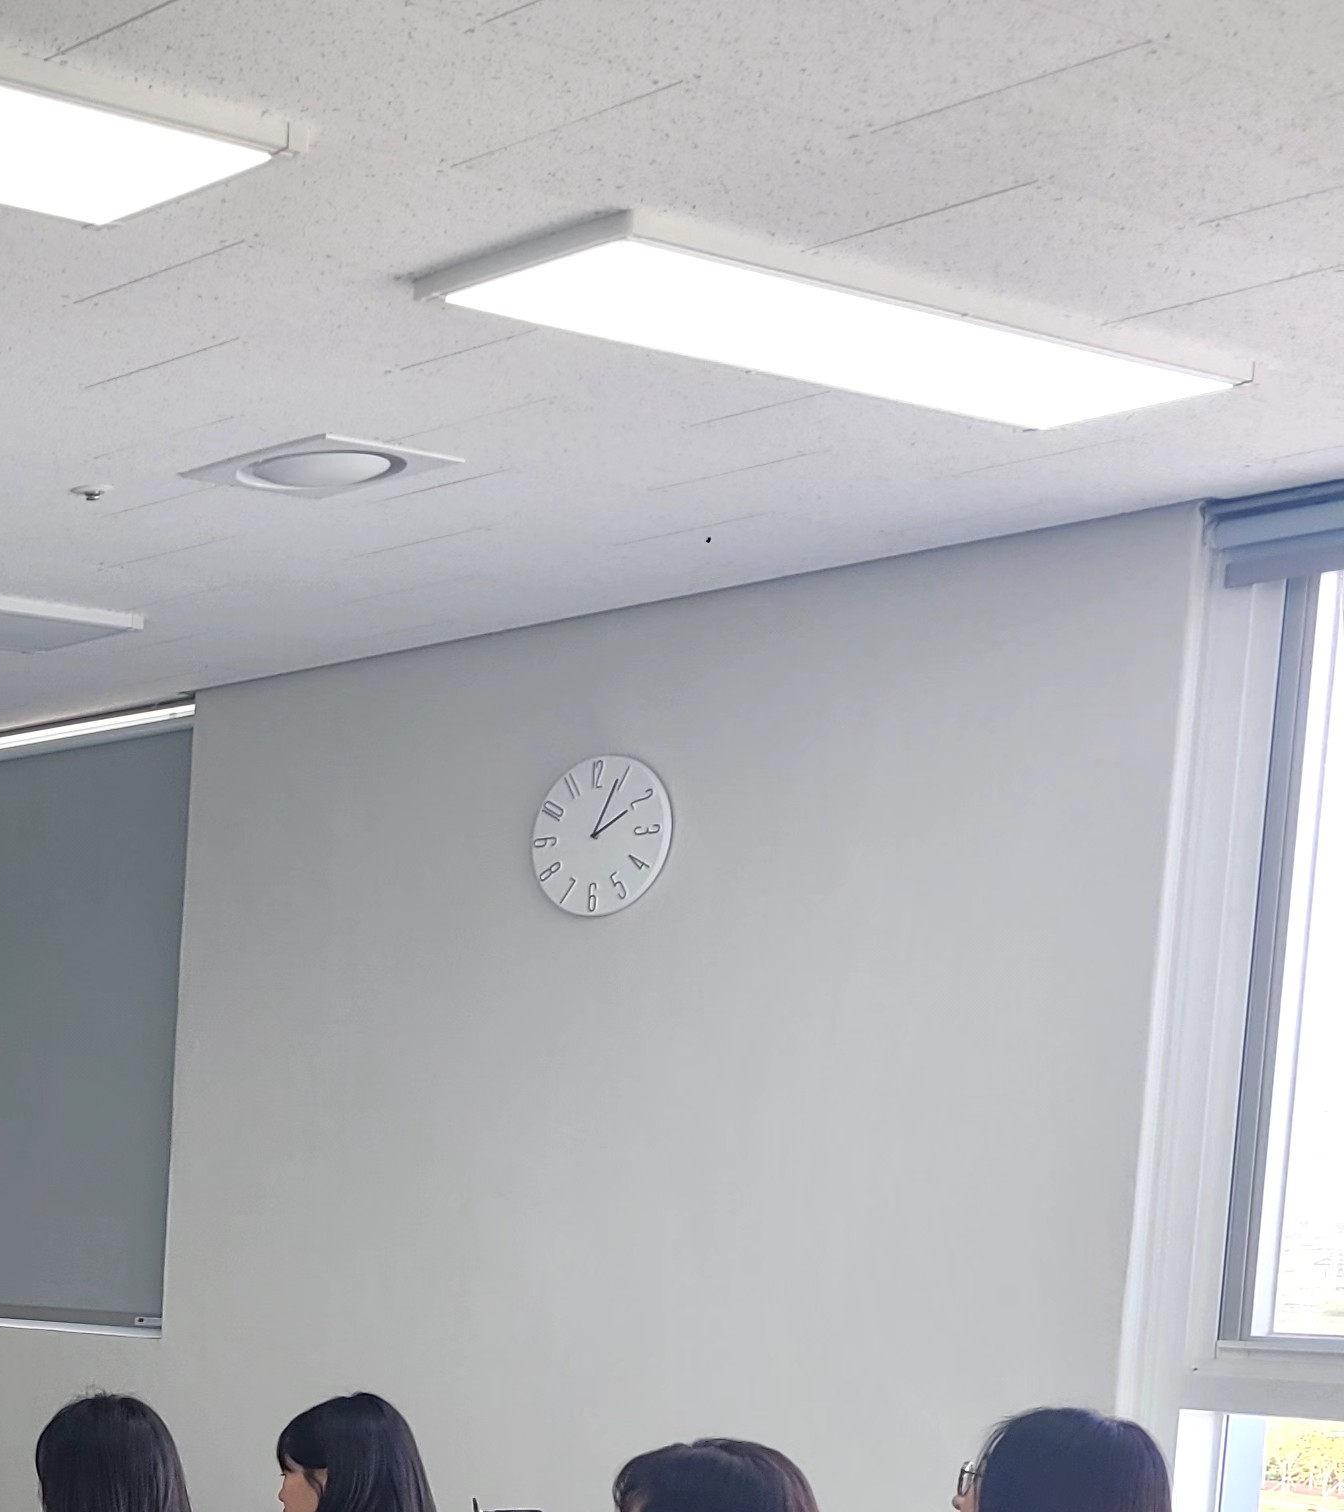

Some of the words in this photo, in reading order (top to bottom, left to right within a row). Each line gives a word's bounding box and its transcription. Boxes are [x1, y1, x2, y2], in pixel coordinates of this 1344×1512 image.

[592, 760, 603, 788] 12
[630, 788, 653, 810] 2
[542, 800, 564, 822] 10
[634, 824, 660, 835] 3
[534, 836, 557, 848] 9
[539, 862, 561, 882] 8
[628, 854, 650, 870] 4
[560, 877, 576, 904] 7
[610, 872, 627, 899] 5
[588, 882, 597, 912] 6
